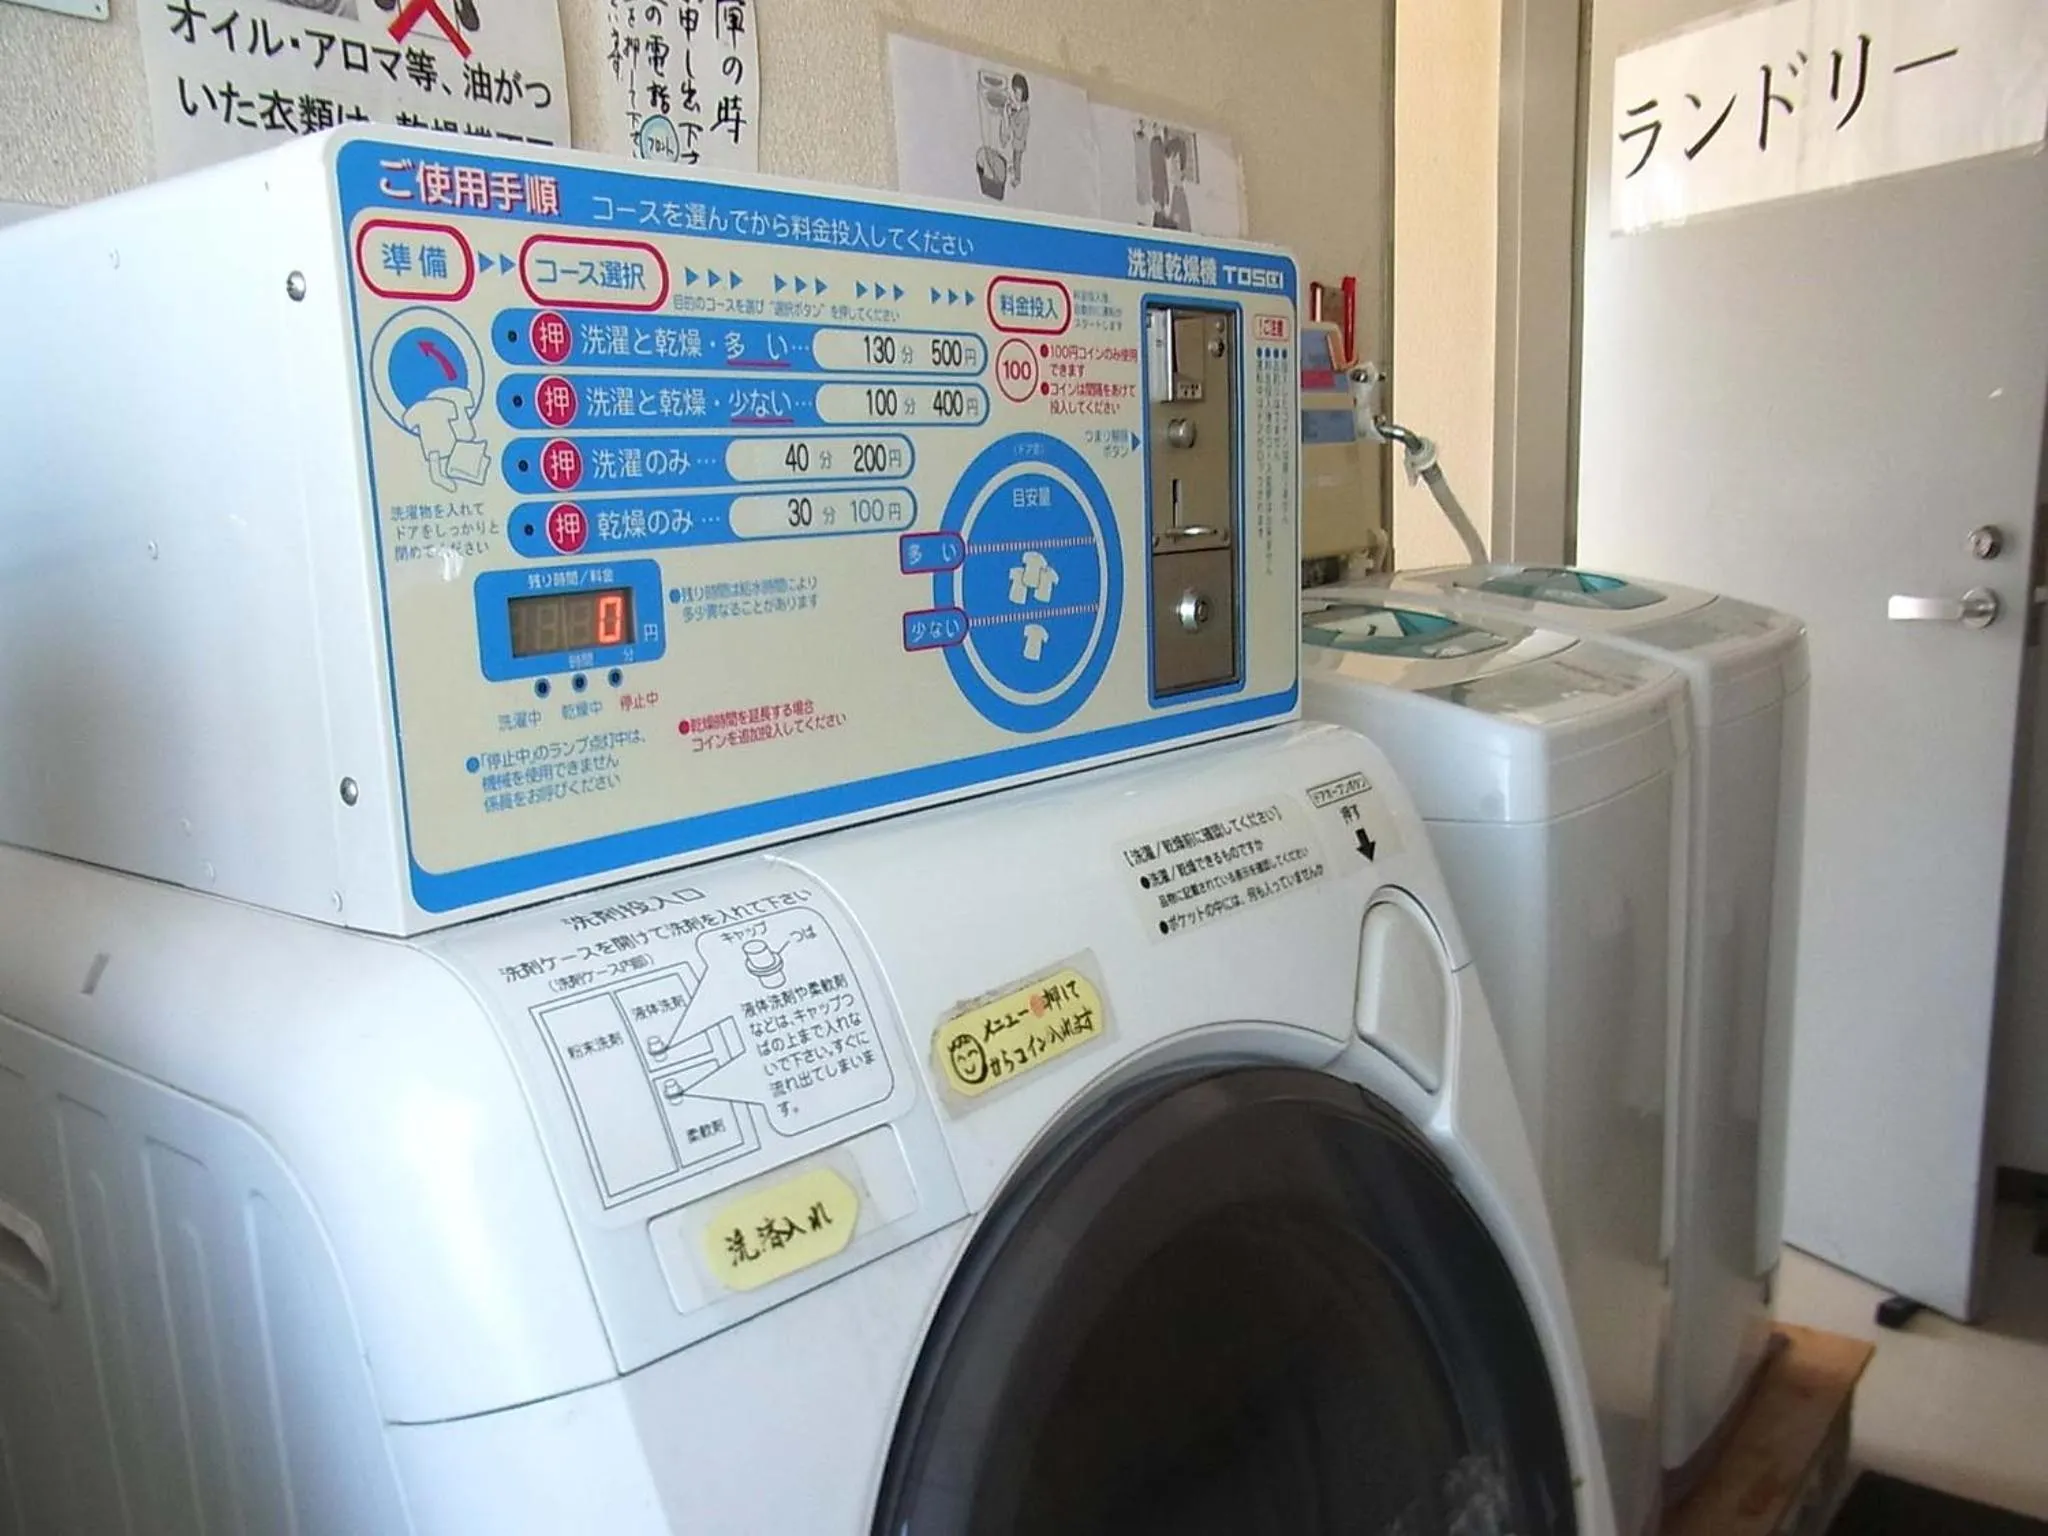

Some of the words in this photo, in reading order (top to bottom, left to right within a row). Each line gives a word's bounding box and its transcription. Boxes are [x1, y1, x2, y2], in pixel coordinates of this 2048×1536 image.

[1618, 33, 1960, 180] ランドリー
[379, 158, 561, 217] ご使用手順
[592, 195, 976, 257] コースを選んでから料金投入してください
[381, 242, 449, 279] 準備
[535, 257, 647, 291] コース選択
[1127, 247, 1218, 287] 洗濯乾燥機
[999, 292, 1060, 320] 料金投入
[538, 322, 565, 354] 押
[1002, 358, 1032, 382] 100
[1049, 363, 1085, 378] できます
[544, 386, 570, 418] 押
[550, 450, 575, 481] 押
[396, 519, 500, 541] ドアをしっかりと
[555, 512, 581, 543] 押
[598, 595, 624, 644] 0
[643, 623, 659, 643] 円
[911, 619, 960, 643] 少ない
[619, 691, 660, 712] 停止中
[562, 886, 706, 932] 洗剤投入口
[498, 888, 813, 984] 洗剤ケースを開けて洗剤を入れて下さい
[720, 921, 769, 944] キャップ
[790, 925, 818, 946] つば
[630, 994, 686, 1023] 液体洗剤
[740, 974, 849, 1018] 液体洗剤や柔軟剤
[748, 993, 856, 1037] などは、キャップつ
[567, 1032, 625, 1060] 粉末洗剤
[756, 1012, 863, 1057] ばの上まで入れな
[764, 1031, 871, 1077] いで下さい。すぐに
[768, 1052, 876, 1097] 流れ出てしまいま
[685, 1119, 727, 1145] 柔軟剤
